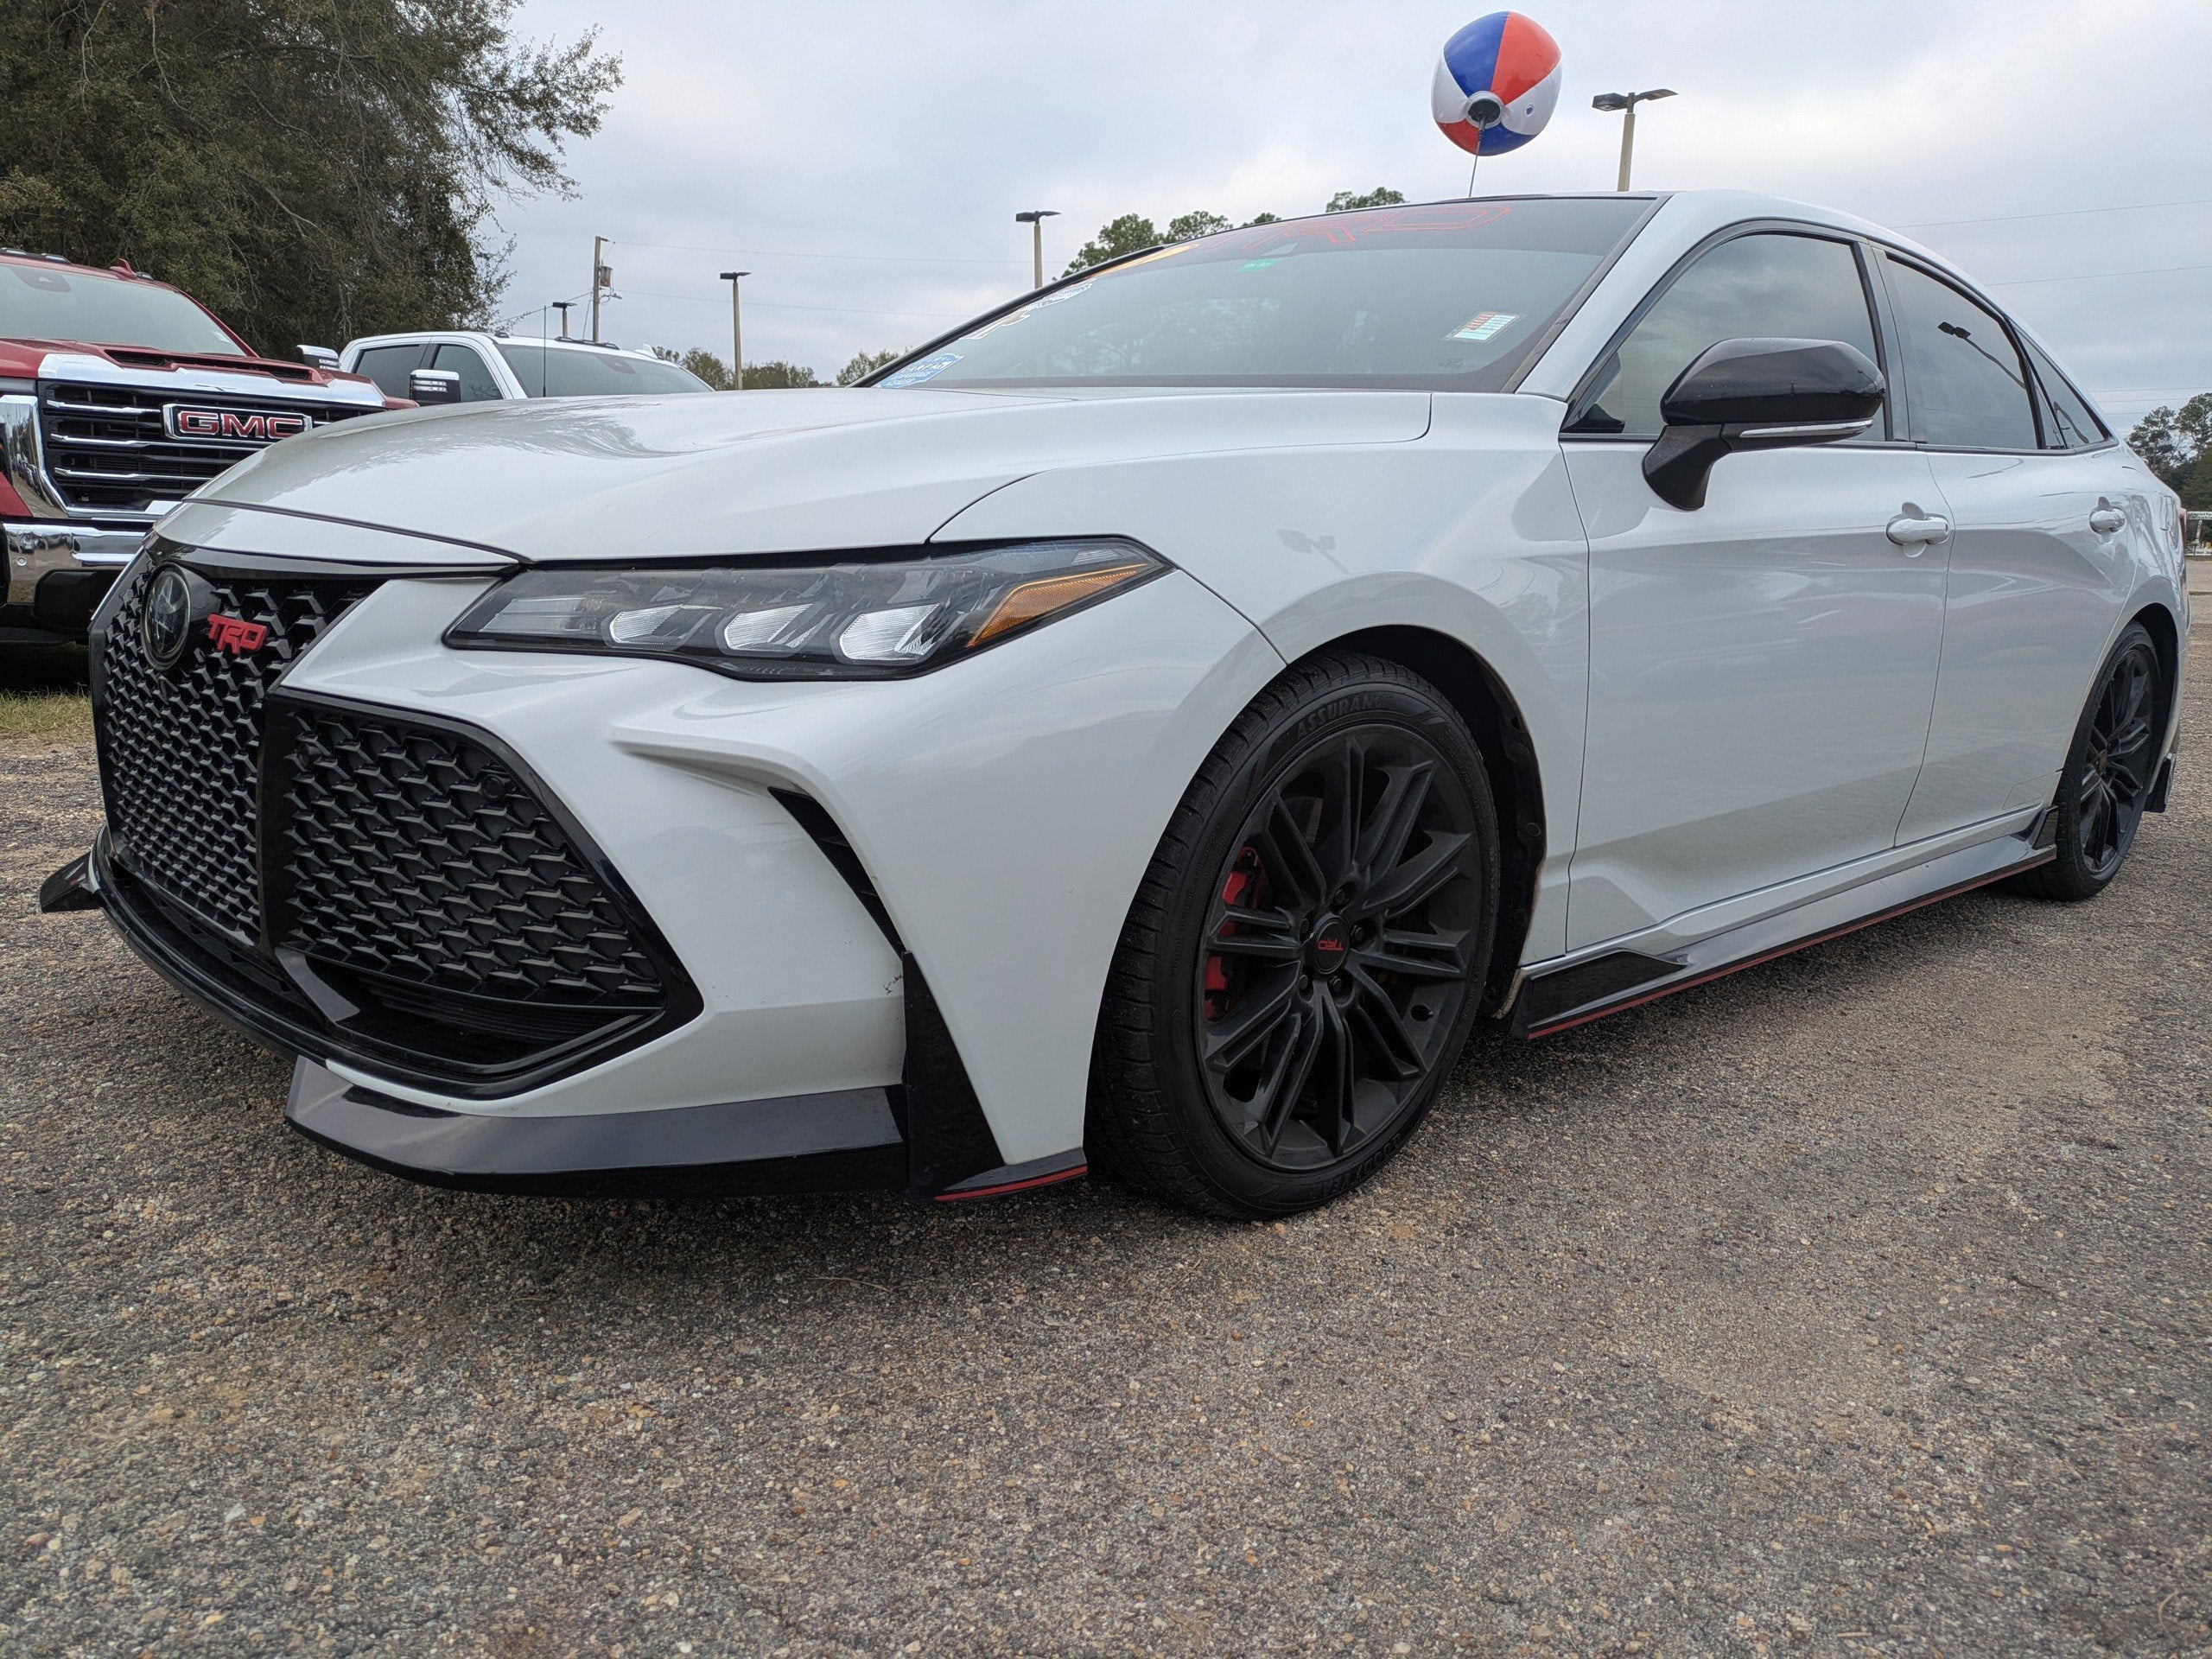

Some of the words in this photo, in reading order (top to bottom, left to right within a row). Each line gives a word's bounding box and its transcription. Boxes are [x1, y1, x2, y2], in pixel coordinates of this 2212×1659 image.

[178, 410, 302, 439] GMC
[207, 613, 267, 654] TRD
[1318, 938, 1344, 951] TRD
